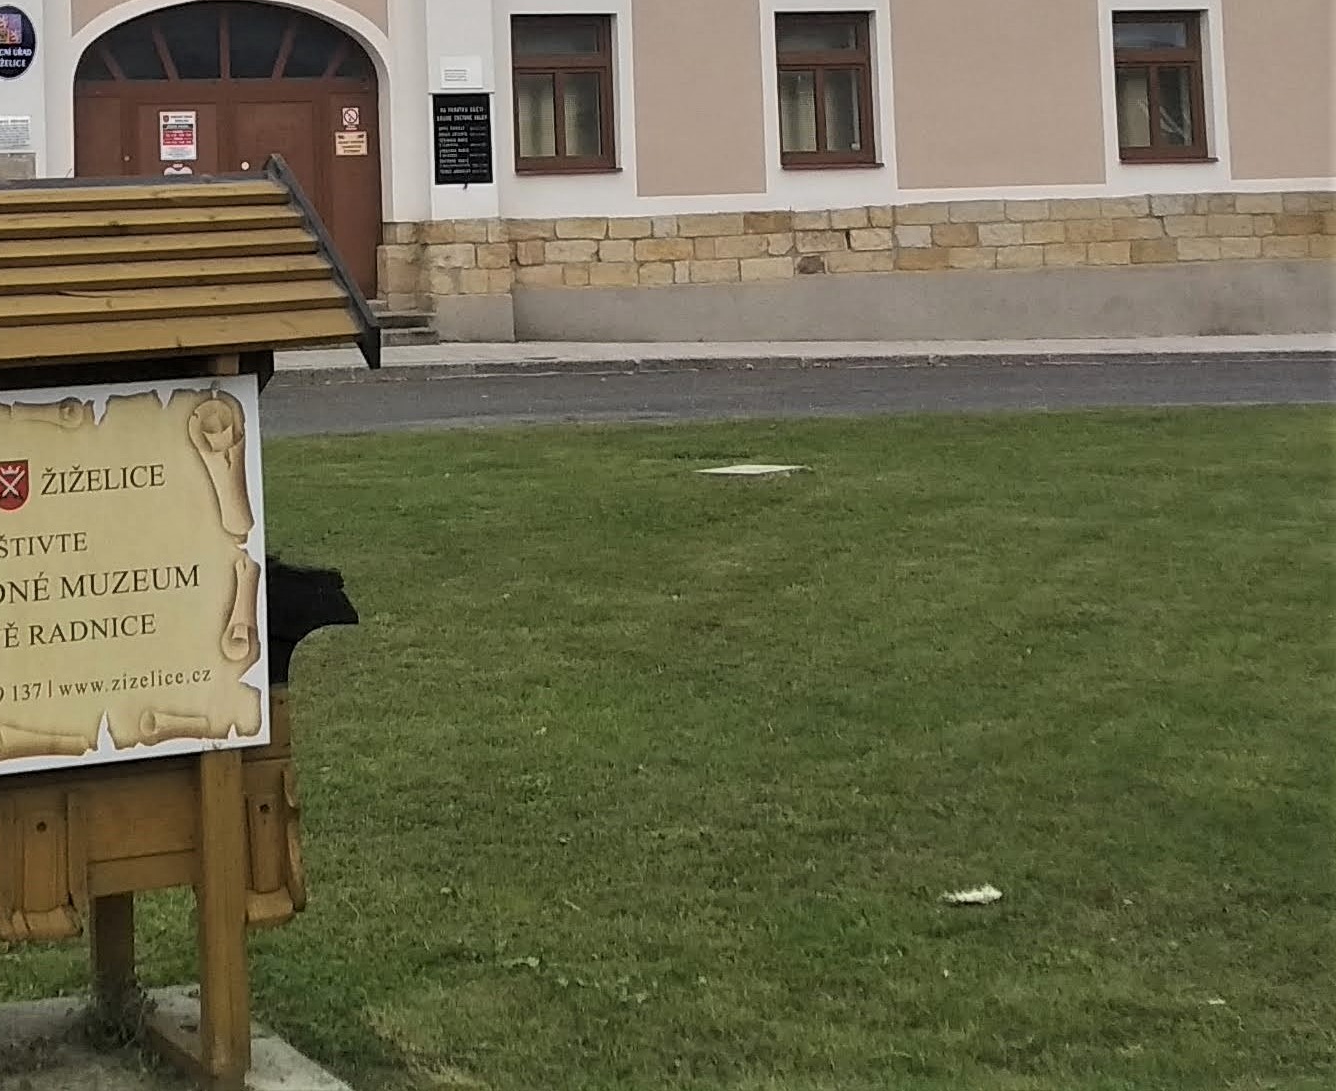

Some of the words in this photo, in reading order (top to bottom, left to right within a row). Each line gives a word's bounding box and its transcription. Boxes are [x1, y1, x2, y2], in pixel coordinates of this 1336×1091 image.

[40, 463, 166, 497] ŽIŽELICE
[59, 564, 200, 601] MUZEUM
[29, 613, 157, 646] RADNICE
[13, 682, 42, 702] 137
[58, 668, 212, 696] www.zizelice.cz
